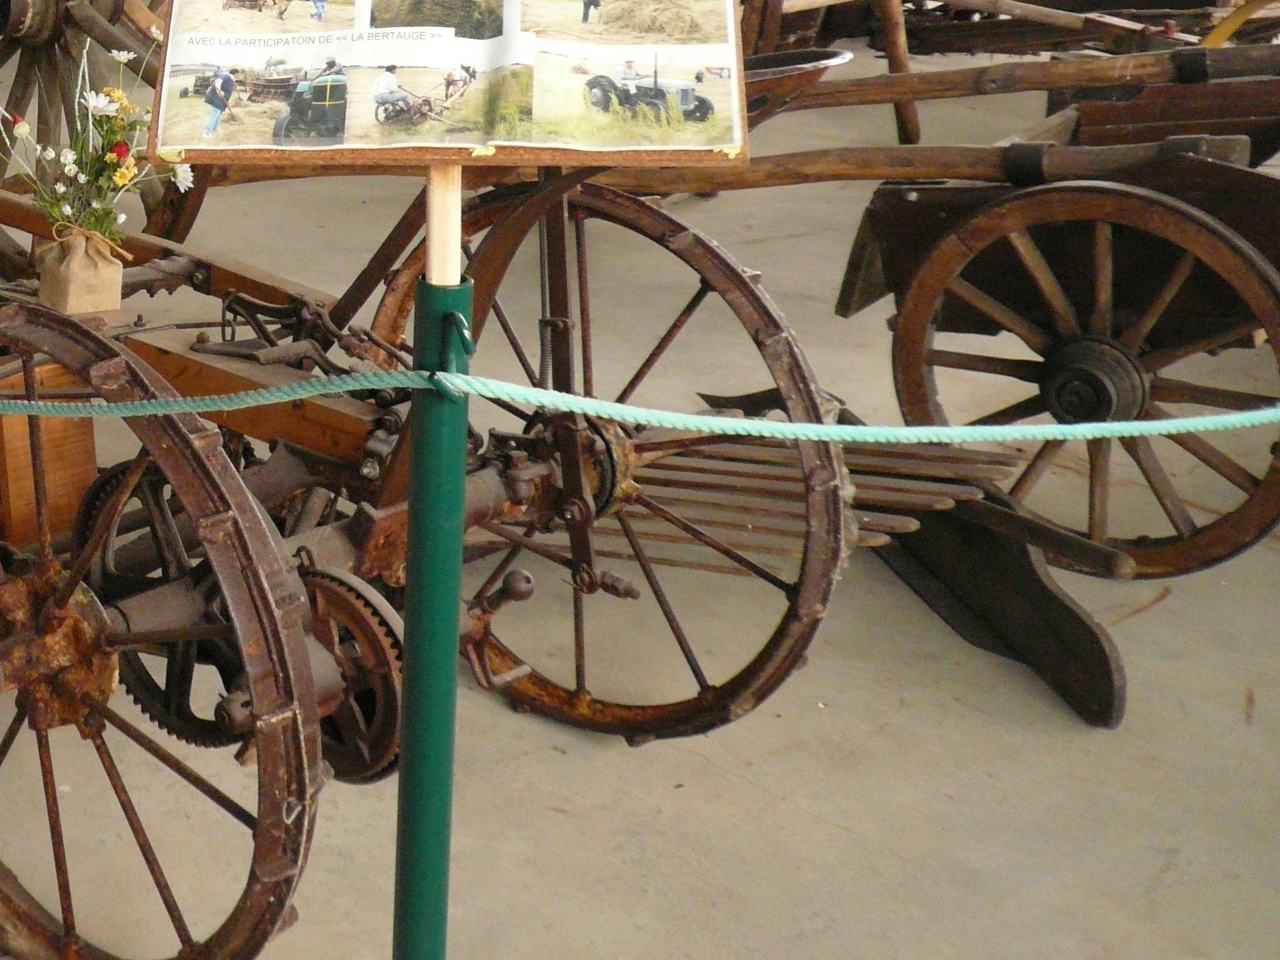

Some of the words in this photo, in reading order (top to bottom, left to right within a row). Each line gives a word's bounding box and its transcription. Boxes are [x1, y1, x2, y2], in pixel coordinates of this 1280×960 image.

[187, 36, 216, 46] AVEC
[219, 37, 232, 46] LA
[234, 36, 315, 48] PARTICIPATOIN
[318, 35, 333, 44] DE
[351, 33, 364, 42] LA
[367, 31, 427, 41] BERTAUGE
